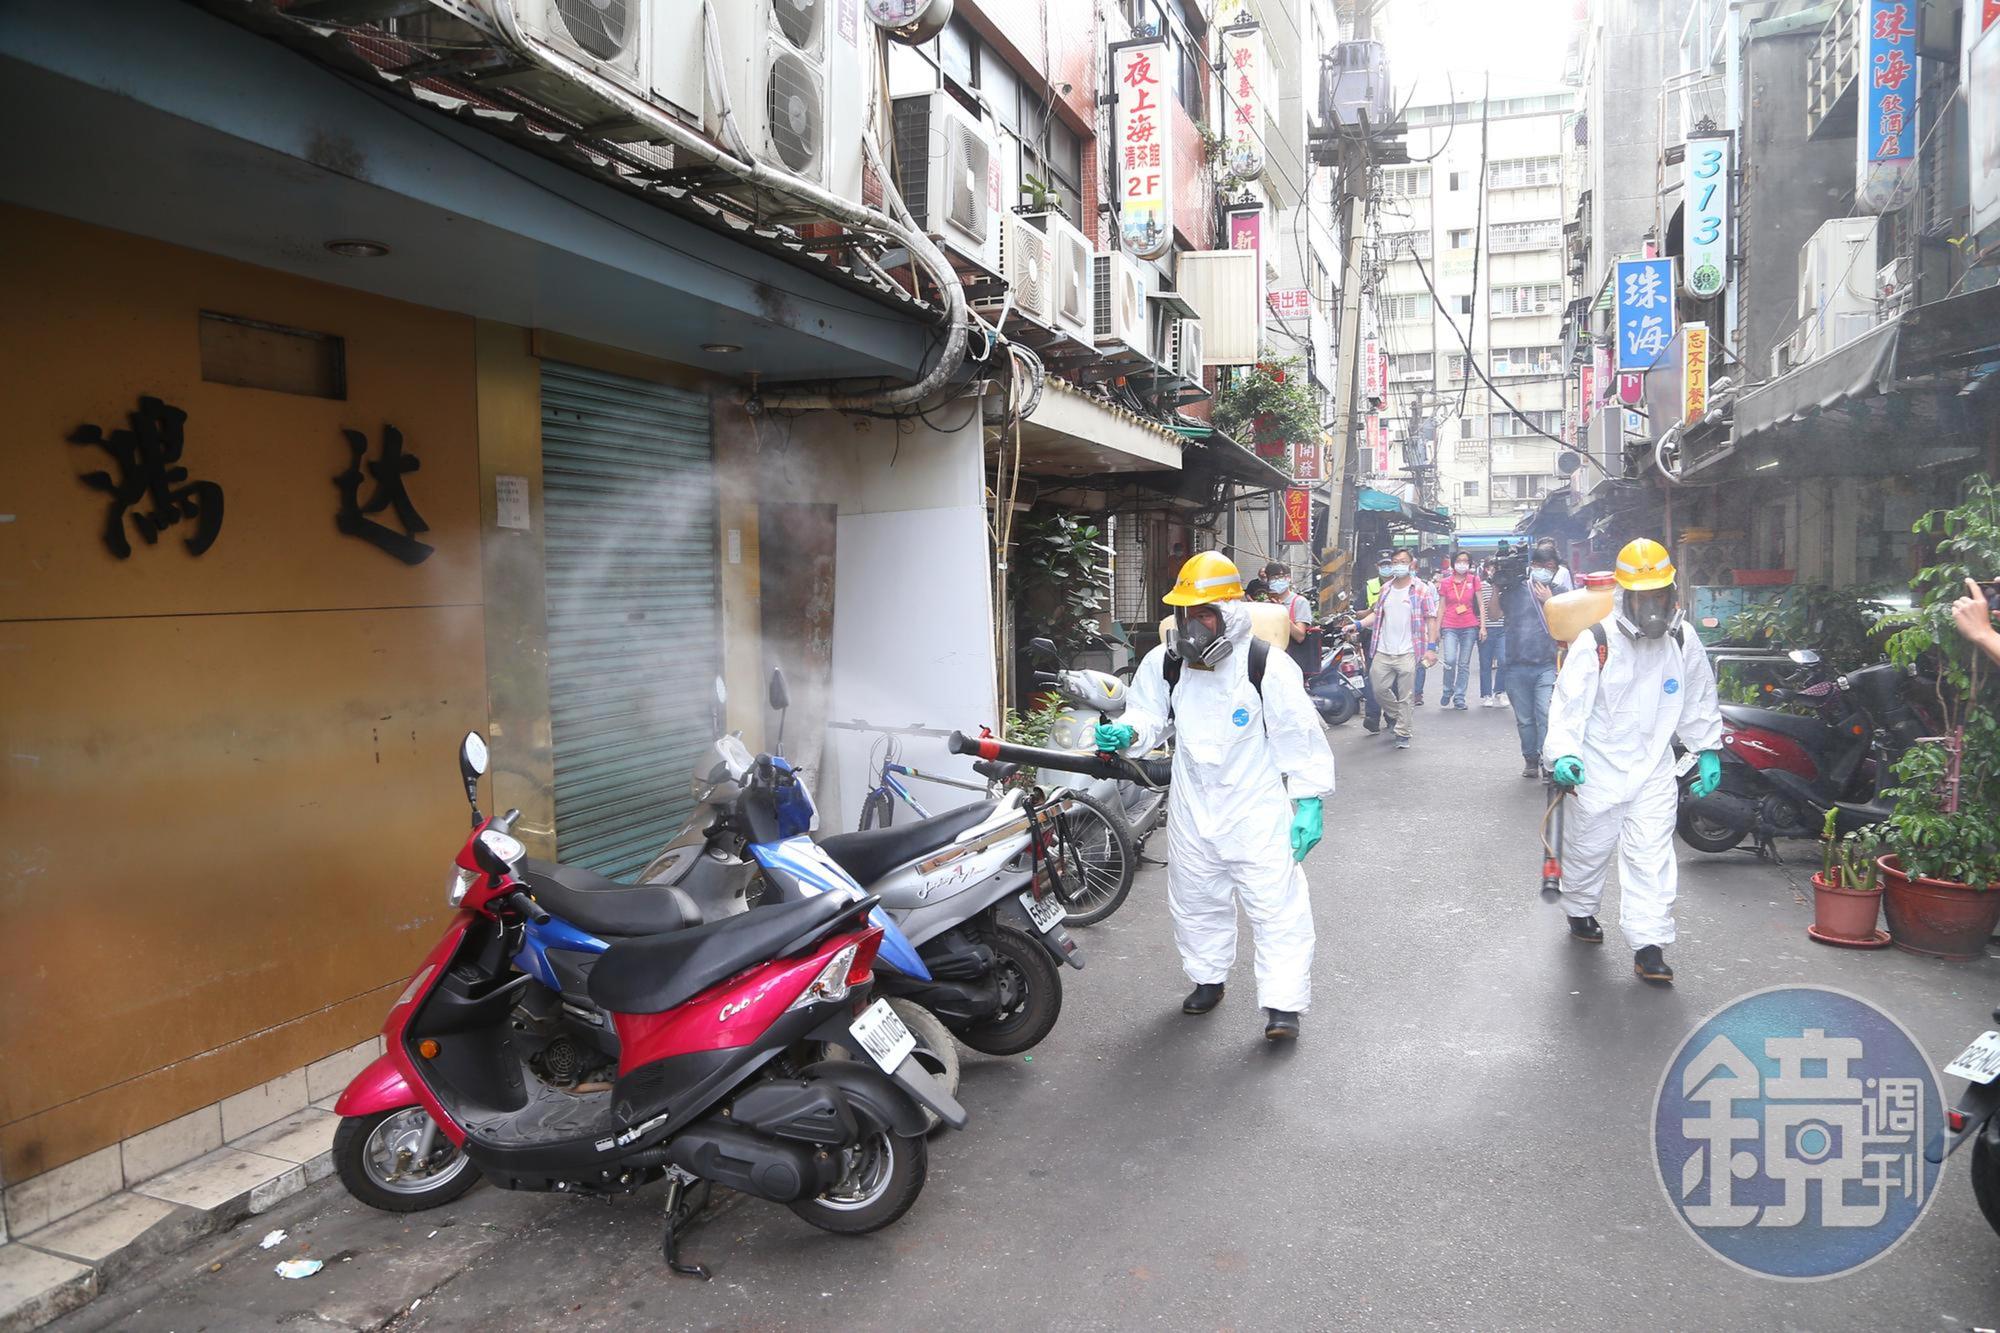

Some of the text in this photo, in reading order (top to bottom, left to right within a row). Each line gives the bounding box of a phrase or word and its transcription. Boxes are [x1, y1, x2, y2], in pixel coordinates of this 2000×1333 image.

[1123, 52, 1160, 143] 夜上海
[1124, 143, 1161, 172] 清茶館
[1127, 175, 1161, 197] 2F
[1692, 149, 1722, 246] 313
[1623, 264, 1669, 357] 珠海
[862, 1012, 907, 1062] NAU-1005
